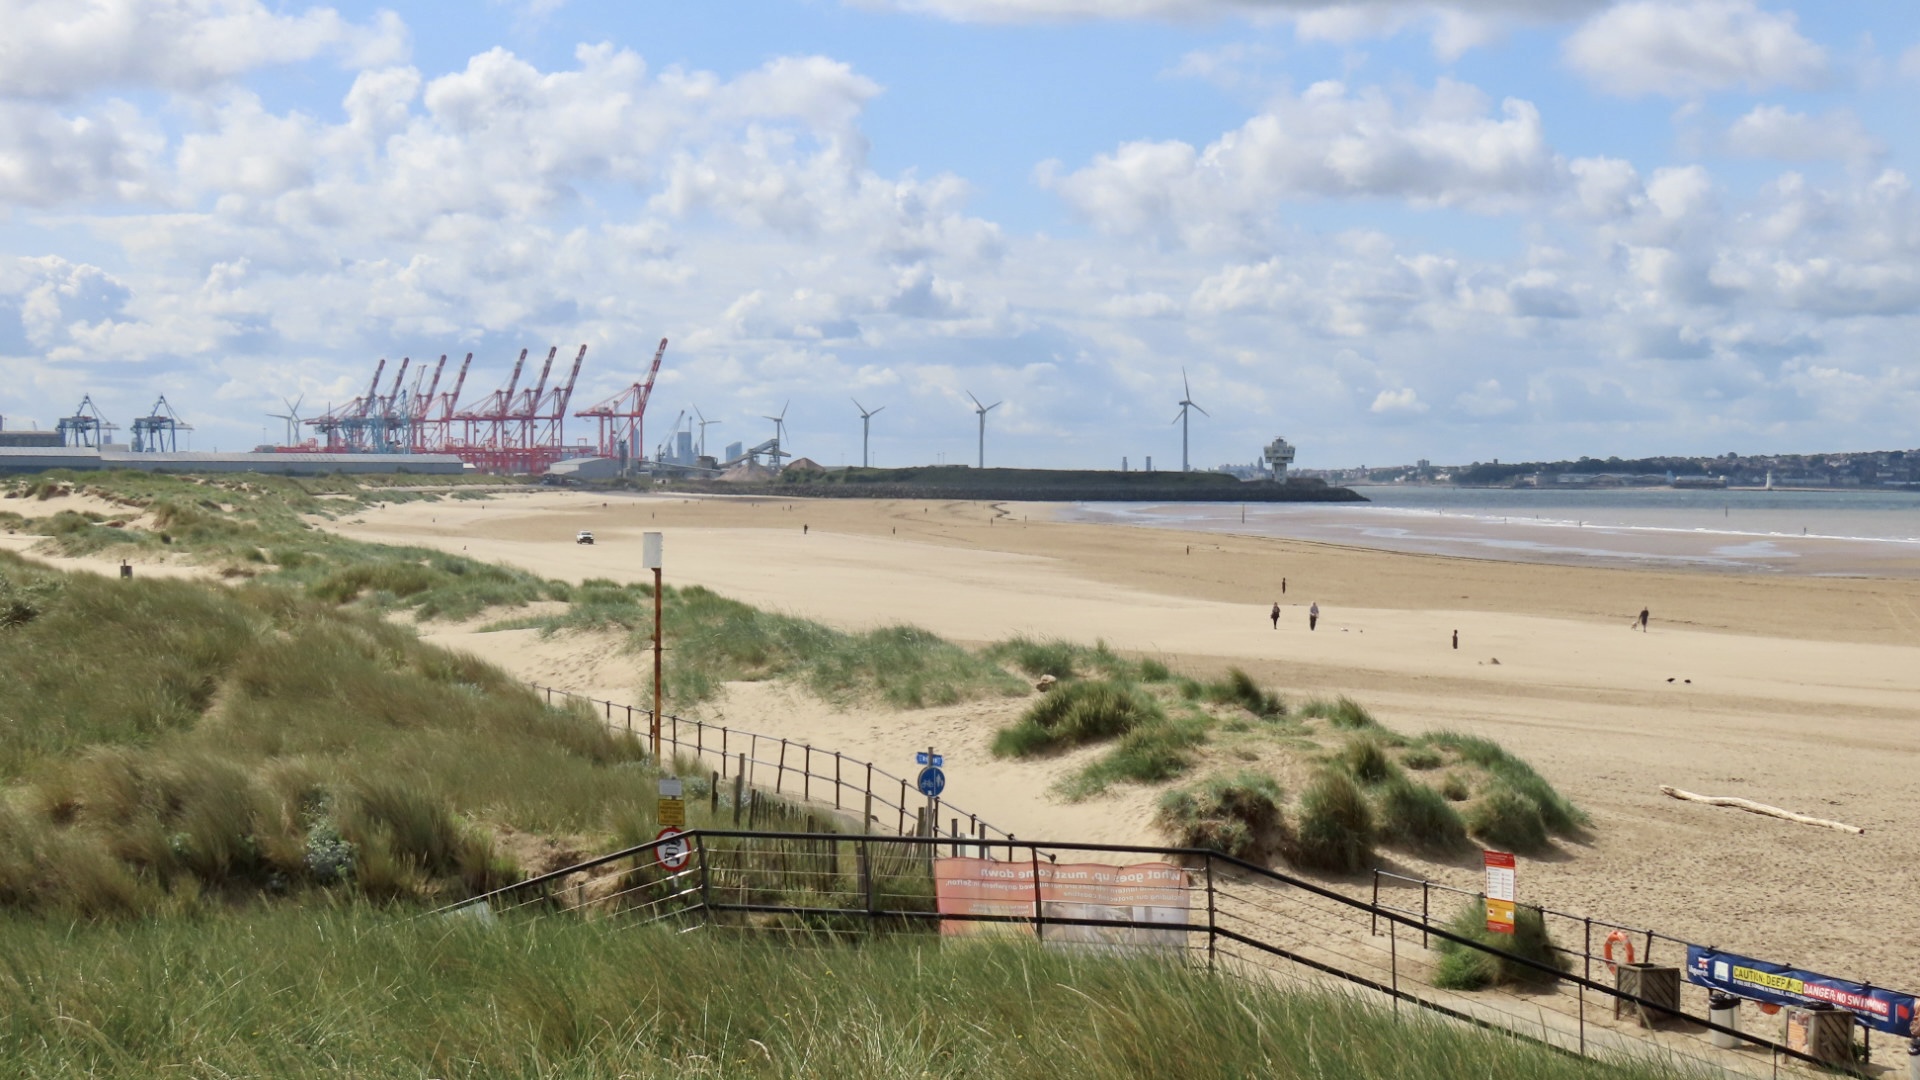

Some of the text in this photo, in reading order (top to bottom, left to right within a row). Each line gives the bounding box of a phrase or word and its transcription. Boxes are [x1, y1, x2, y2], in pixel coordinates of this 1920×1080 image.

[1734, 966, 1764, 983] CAUTION:
[1766, 975, 1786, 988] DEEP
[1786, 979, 1802, 992] MUD
[1803, 983, 1836, 1001] DANGER:
[1836, 992, 1847, 1004] NO
[1847, 995, 1887, 1013] SWIMMING
